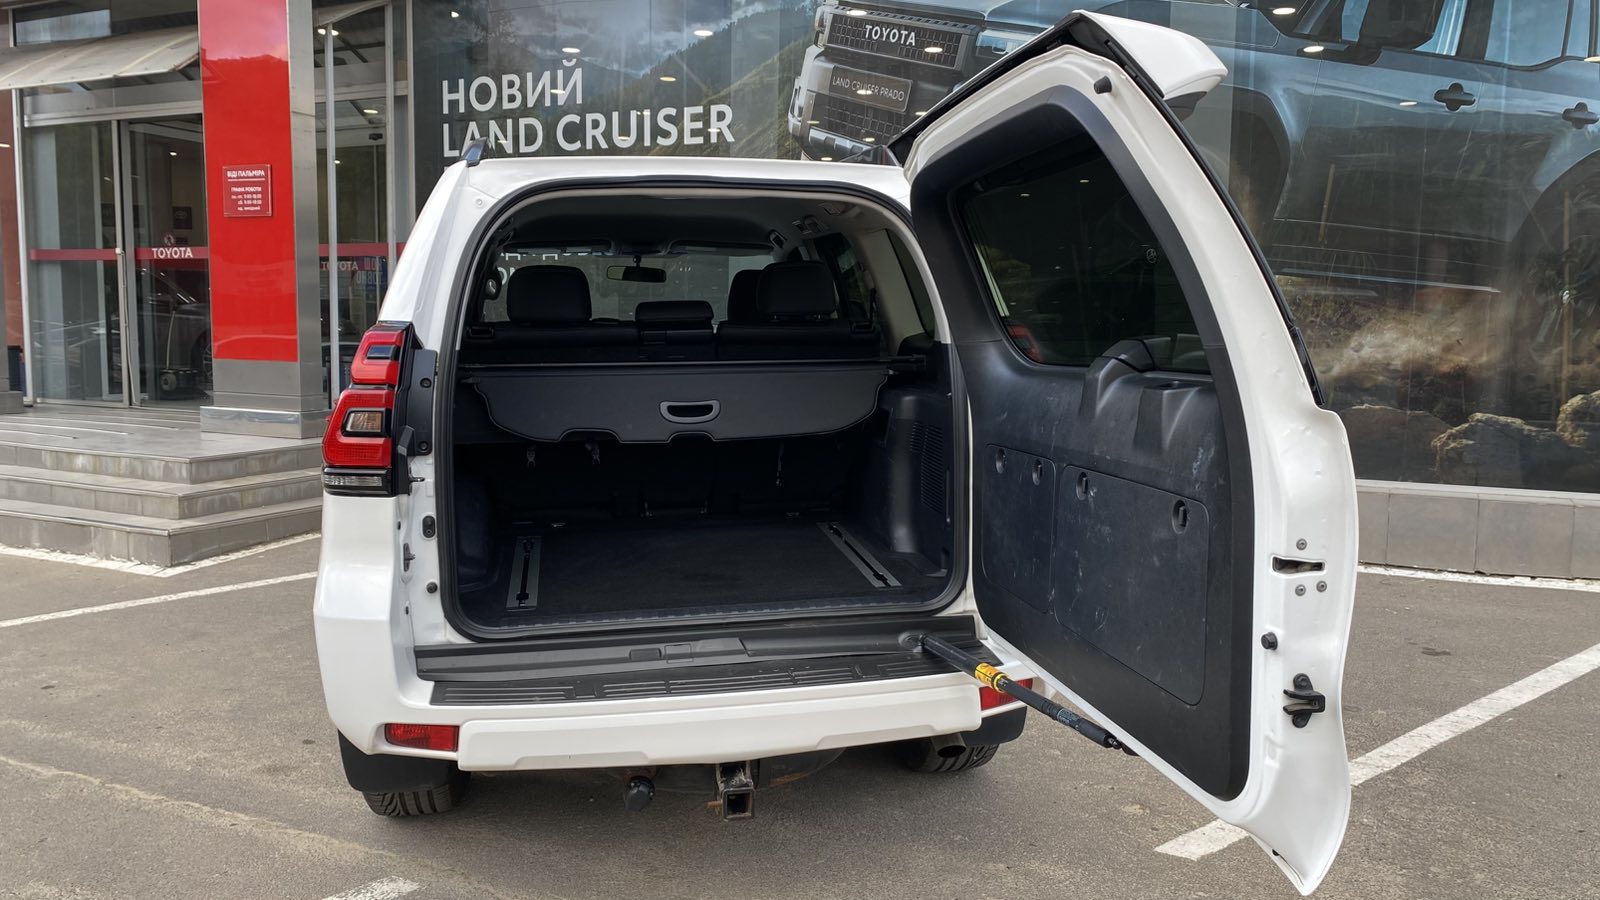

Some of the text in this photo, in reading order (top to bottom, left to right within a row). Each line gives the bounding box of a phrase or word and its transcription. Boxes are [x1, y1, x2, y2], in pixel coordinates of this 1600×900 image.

[865, 25, 916, 46] TOYOTA
[442, 58, 583, 115] НОВИЙ
[832, 76, 904, 101] LAND CRUISER PRADO
[442, 104, 735, 158] LAND CRUISER
[152, 247, 193, 259] TOYOTA
[321, 261, 359, 271] TOTA
